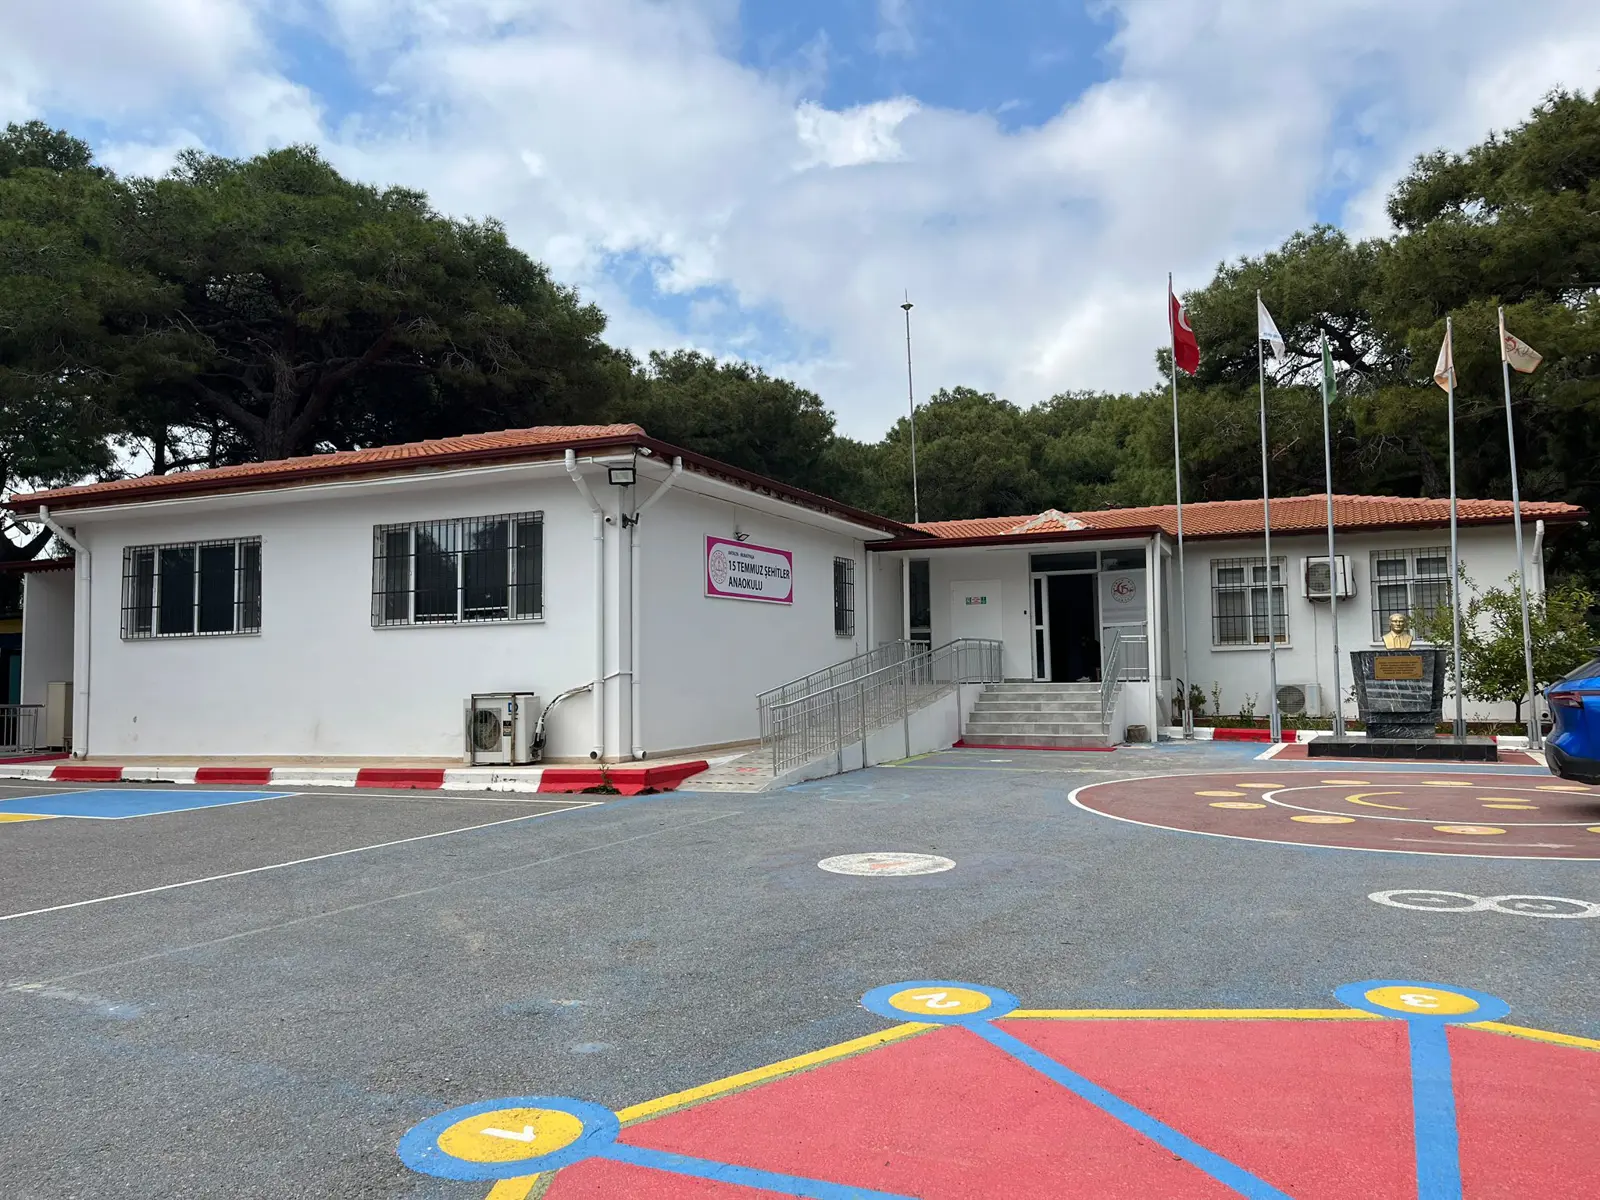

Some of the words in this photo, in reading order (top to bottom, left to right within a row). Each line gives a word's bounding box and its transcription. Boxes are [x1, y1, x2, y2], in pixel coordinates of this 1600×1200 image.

[728, 560, 736, 572] 15
[737, 561, 763, 576] TEMMUZ
[764, 565, 790, 579] ŞEHİTLER
[728, 576, 763, 591] ANAOKULU
[911, 992, 961, 1009] 2
[1400, 993, 1440, 1008] 3
[480, 1125, 536, 1142] 1
